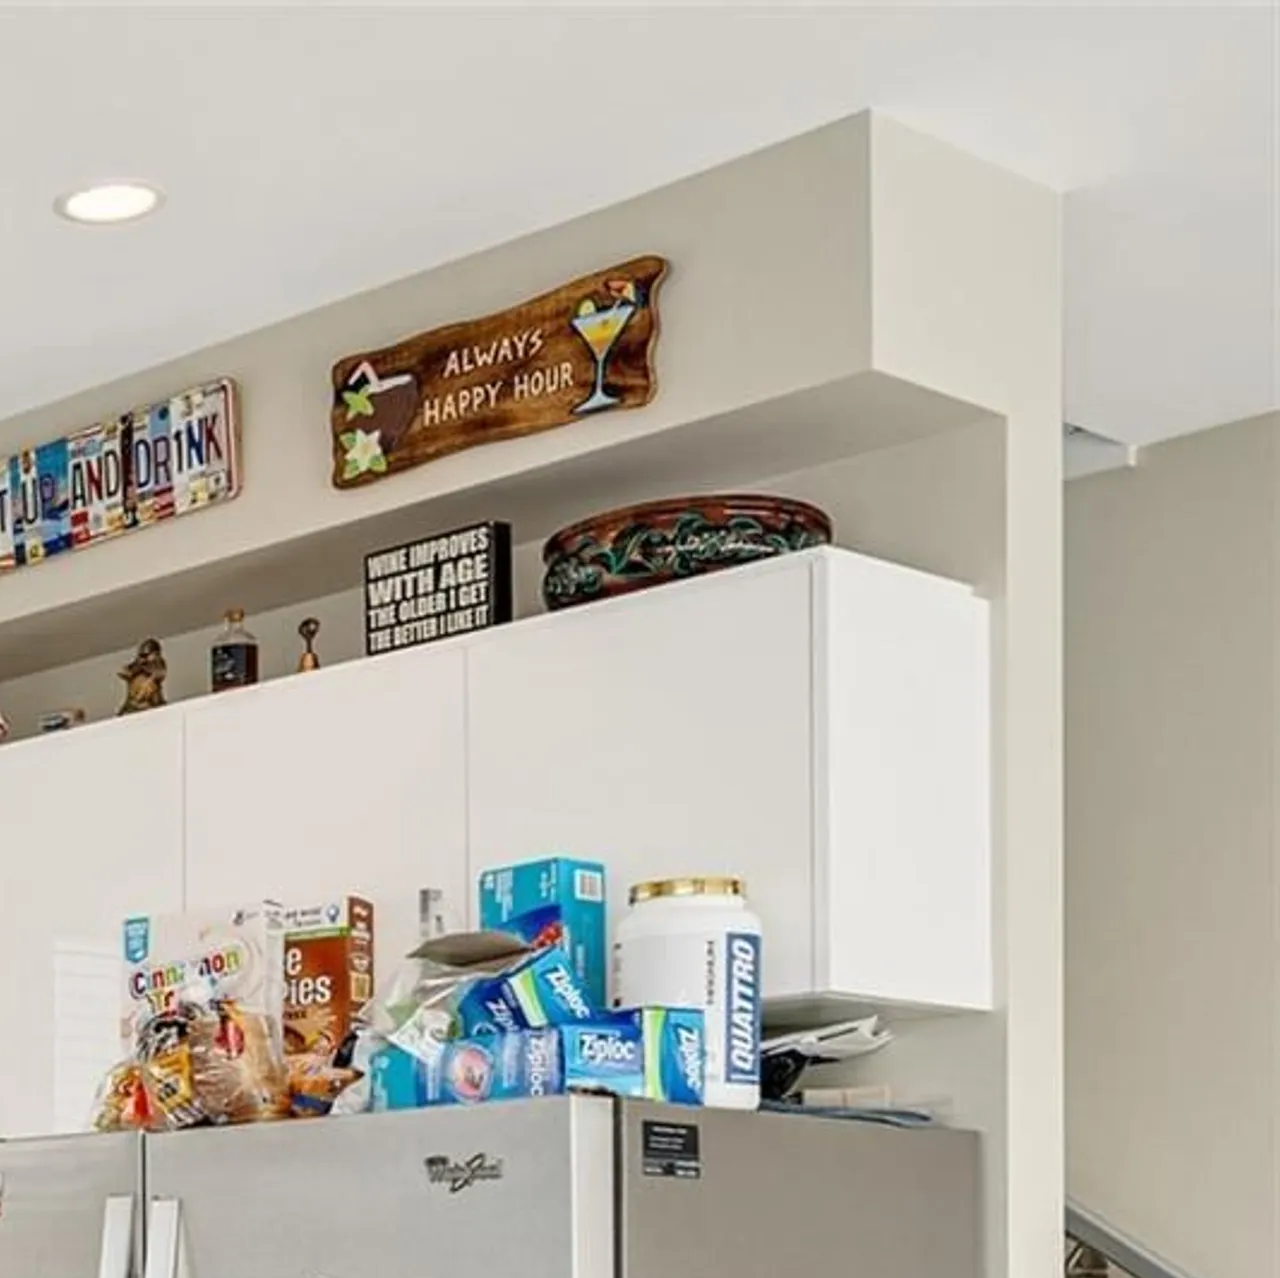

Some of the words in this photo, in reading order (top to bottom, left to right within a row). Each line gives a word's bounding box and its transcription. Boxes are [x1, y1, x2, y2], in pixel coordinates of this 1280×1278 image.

[443, 328, 544, 378] ALWAYS
[423, 382, 502, 427] HAPPY
[513, 361, 574, 401] HOUR
[21, 474, 56, 524] UP
[70, 450, 120, 510] AND
[368, 548, 408, 580] WINE
[409, 527, 489, 568] IMPROVES
[369, 567, 434, 606] WITH
[440, 553, 488, 589] AGE
[369, 603, 397, 630] THE
[399, 592, 446, 621] OLDER
[449, 588, 456, 610] I
[459, 581, 488, 606] GET
[369, 628, 391, 651] THE
[394, 617, 437, 645] BETTER
[440, 614, 446, 635] I
[447, 608, 473, 632] LIKE
[475, 605, 489, 626] IT
[544, 963, 591, 1020] Ziploc
[731, 938, 755, 1071] QUATTRO
[580, 1034, 636, 1066] Ziploc
[677, 1027, 702, 1090] Ziploc
